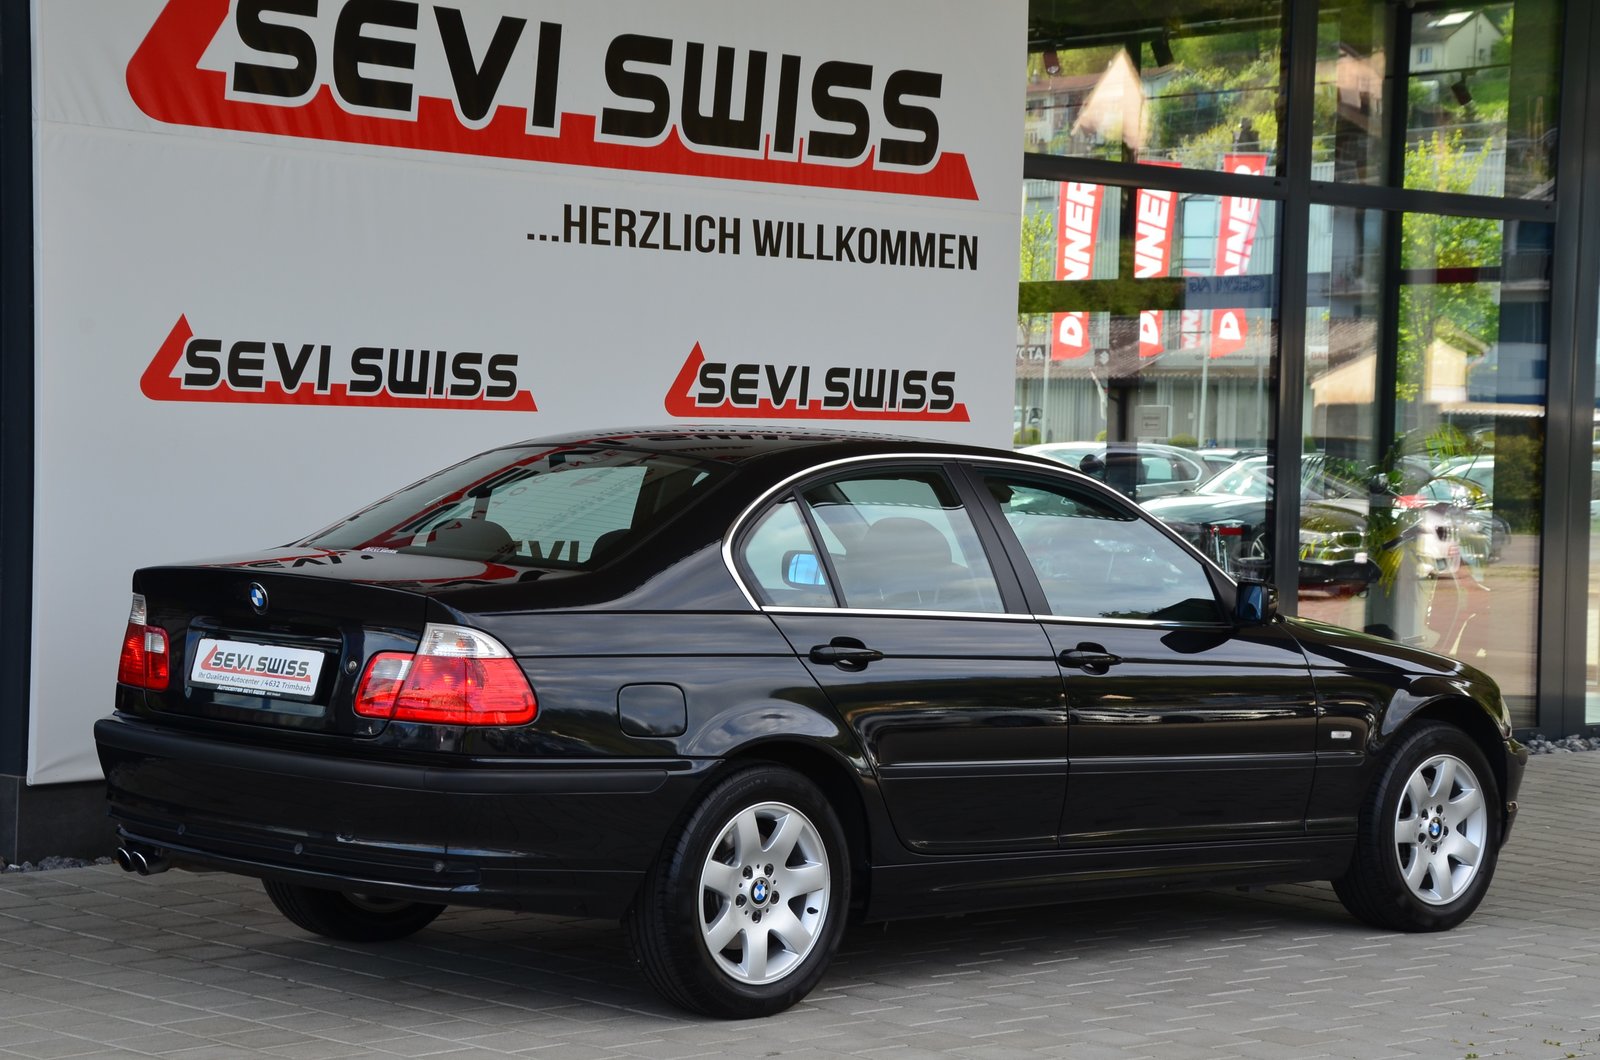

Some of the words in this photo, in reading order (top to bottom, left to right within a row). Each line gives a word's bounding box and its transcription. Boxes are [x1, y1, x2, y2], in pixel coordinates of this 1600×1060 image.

[231, 0, 563, 130] SEVI
[600, 33, 943, 168] SWISS
[752, 219, 978, 271] WILLKOMMEN
[184, 338, 332, 392] SEVI
[349, 347, 519, 398] SWISS
[697, 362, 810, 406] SEVI
[823, 367, 956, 410] SWISS
[212, 651, 254, 671] SEVI
[256, 656, 310, 677] SWISS
[229, 676, 260, 686] Autocenter
[281, 682, 311, 692] Trimbach
